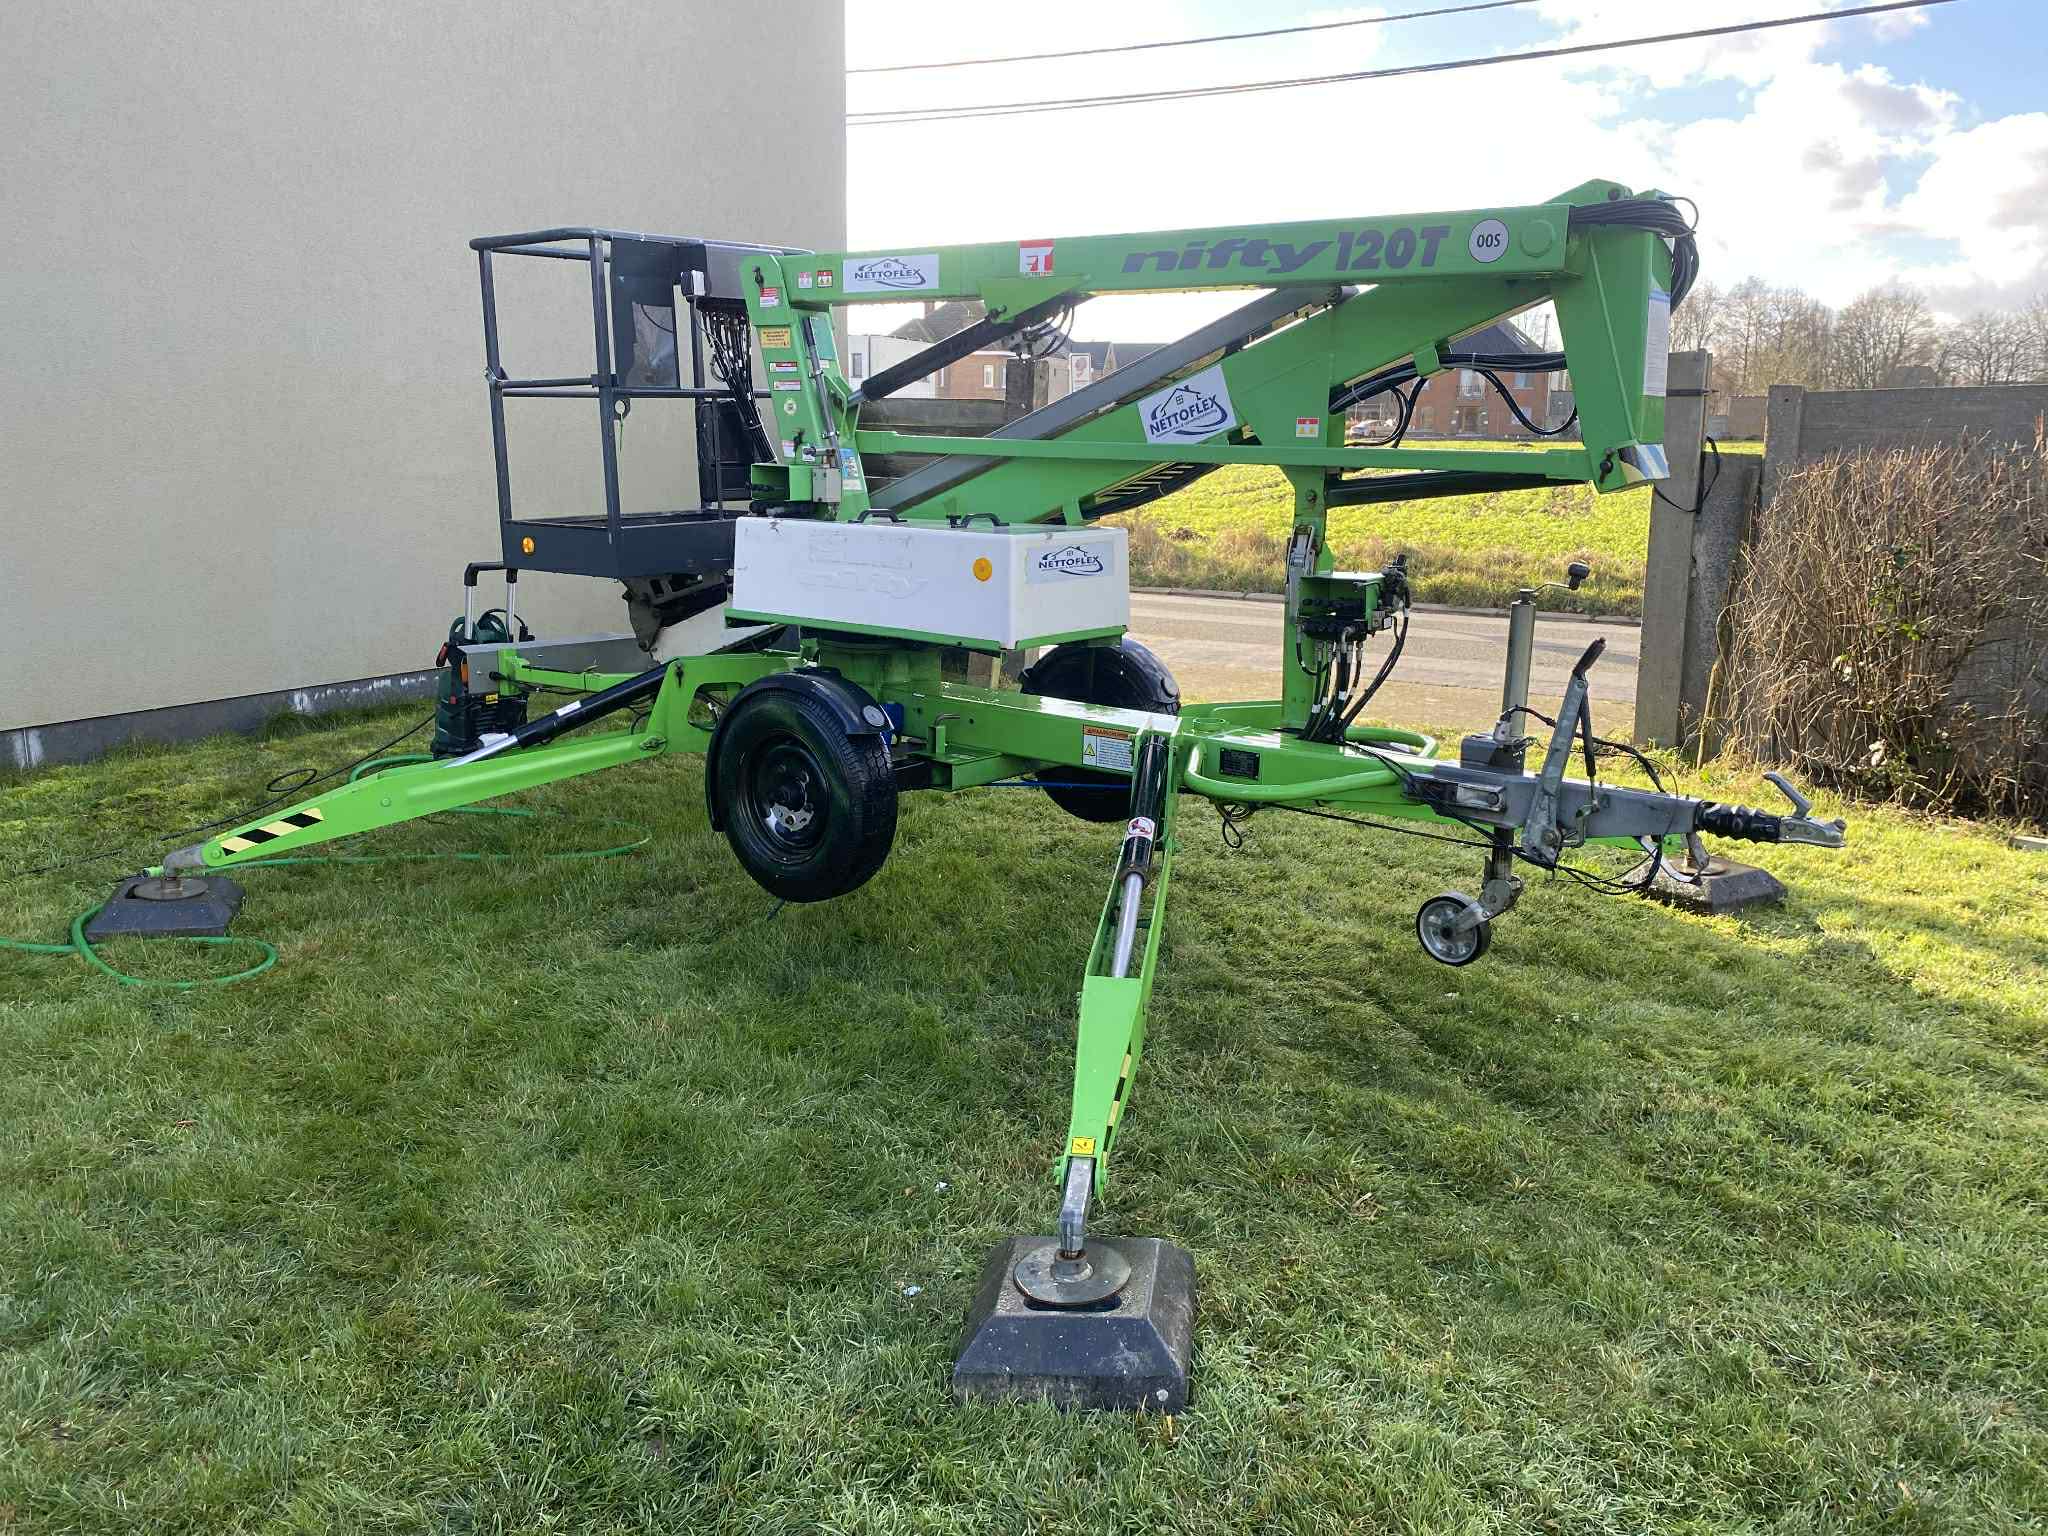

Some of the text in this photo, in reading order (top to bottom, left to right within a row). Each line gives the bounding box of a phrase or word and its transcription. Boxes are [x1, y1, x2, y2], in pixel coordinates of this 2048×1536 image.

[1121, 225, 1450, 273] nifty 120T
[854, 268, 921, 280] NETTOFLEX
[1149, 394, 1217, 436] NETTOFLEX
[1038, 555, 1099, 569] NETTOFLEX
